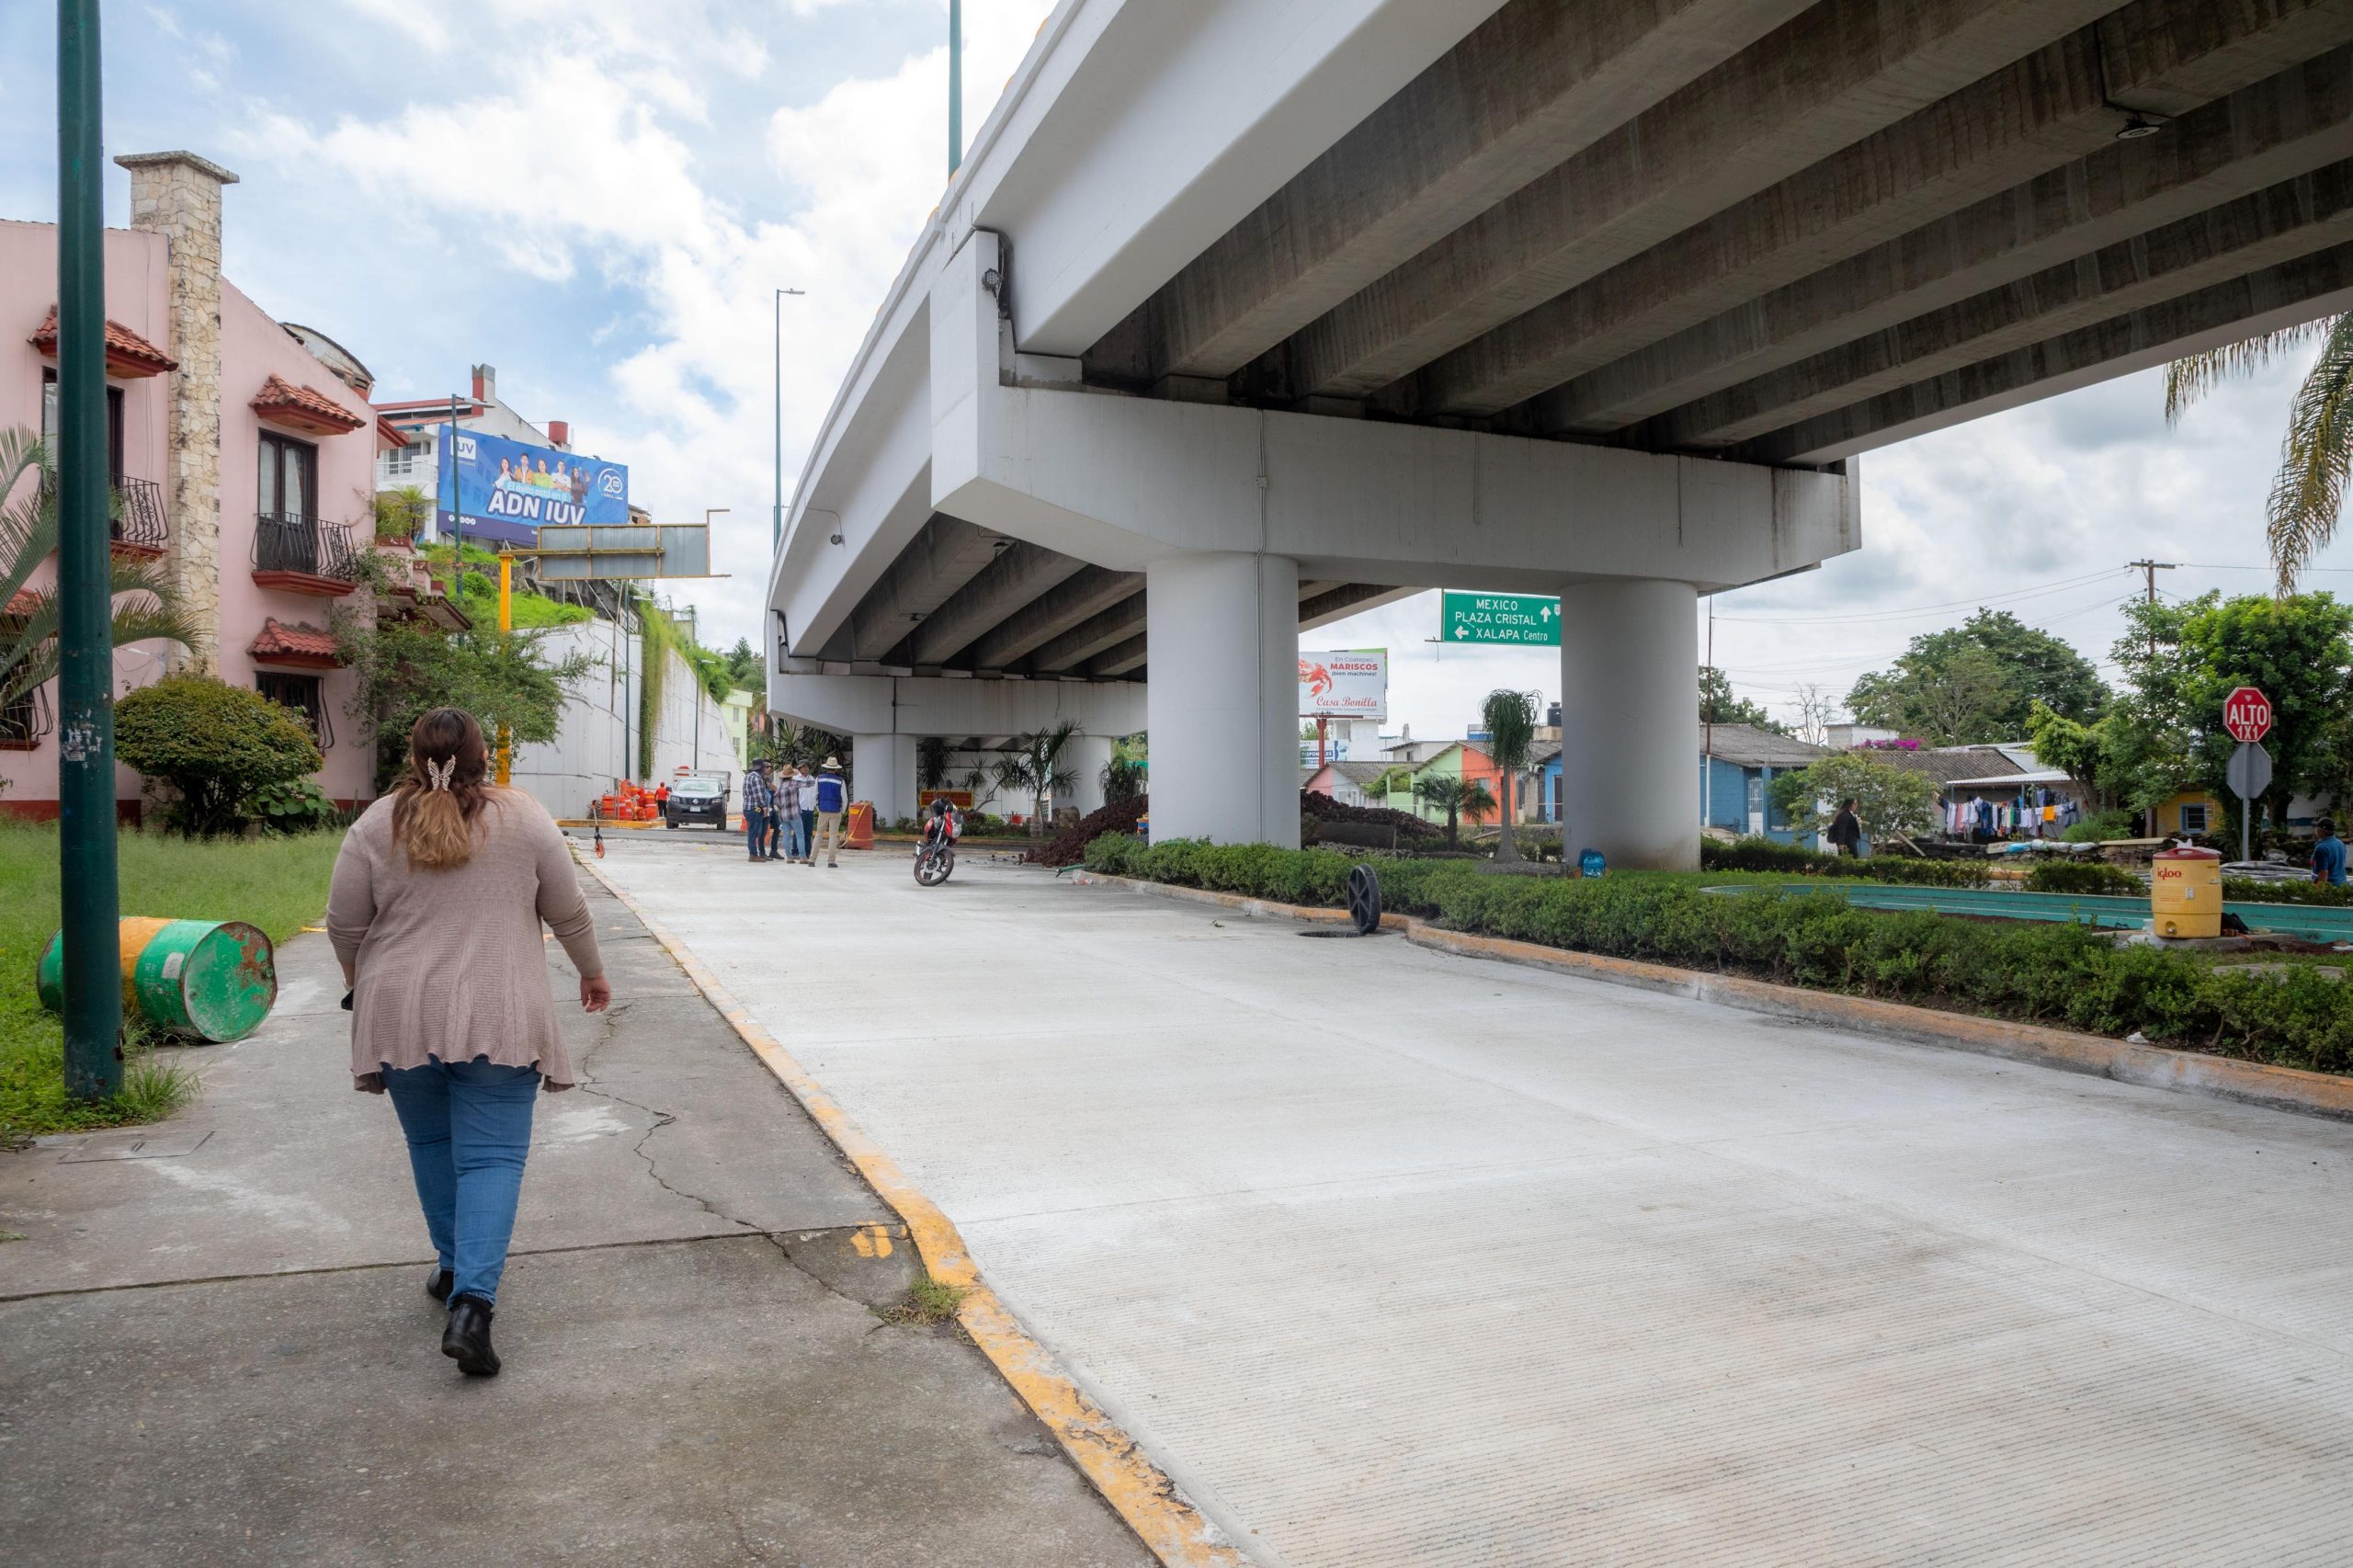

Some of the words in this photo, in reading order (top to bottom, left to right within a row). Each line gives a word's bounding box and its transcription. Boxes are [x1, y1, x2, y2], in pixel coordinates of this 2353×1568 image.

[455, 441, 474, 455] UV
[603, 473, 623, 494] 20
[487, 490, 540, 519] ADN
[545, 499, 585, 527] IUV
[1476, 598, 1518, 611] MEXICO
[1455, 611, 1492, 623] PLAZA
[1495, 613, 1537, 626] CRISTAL
[1476, 628, 1520, 640] XALAPA
[1523, 630, 1548, 642] Centro
[1330, 663, 1378, 671] MARISCOS
[1316, 696, 1339, 707] Casa
[1342, 696, 1377, 707] Bonilla
[2229, 704, 2268, 726] ALTO
[2237, 725, 2258, 740] 1X1
[2157, 867, 2182, 881] igloo
